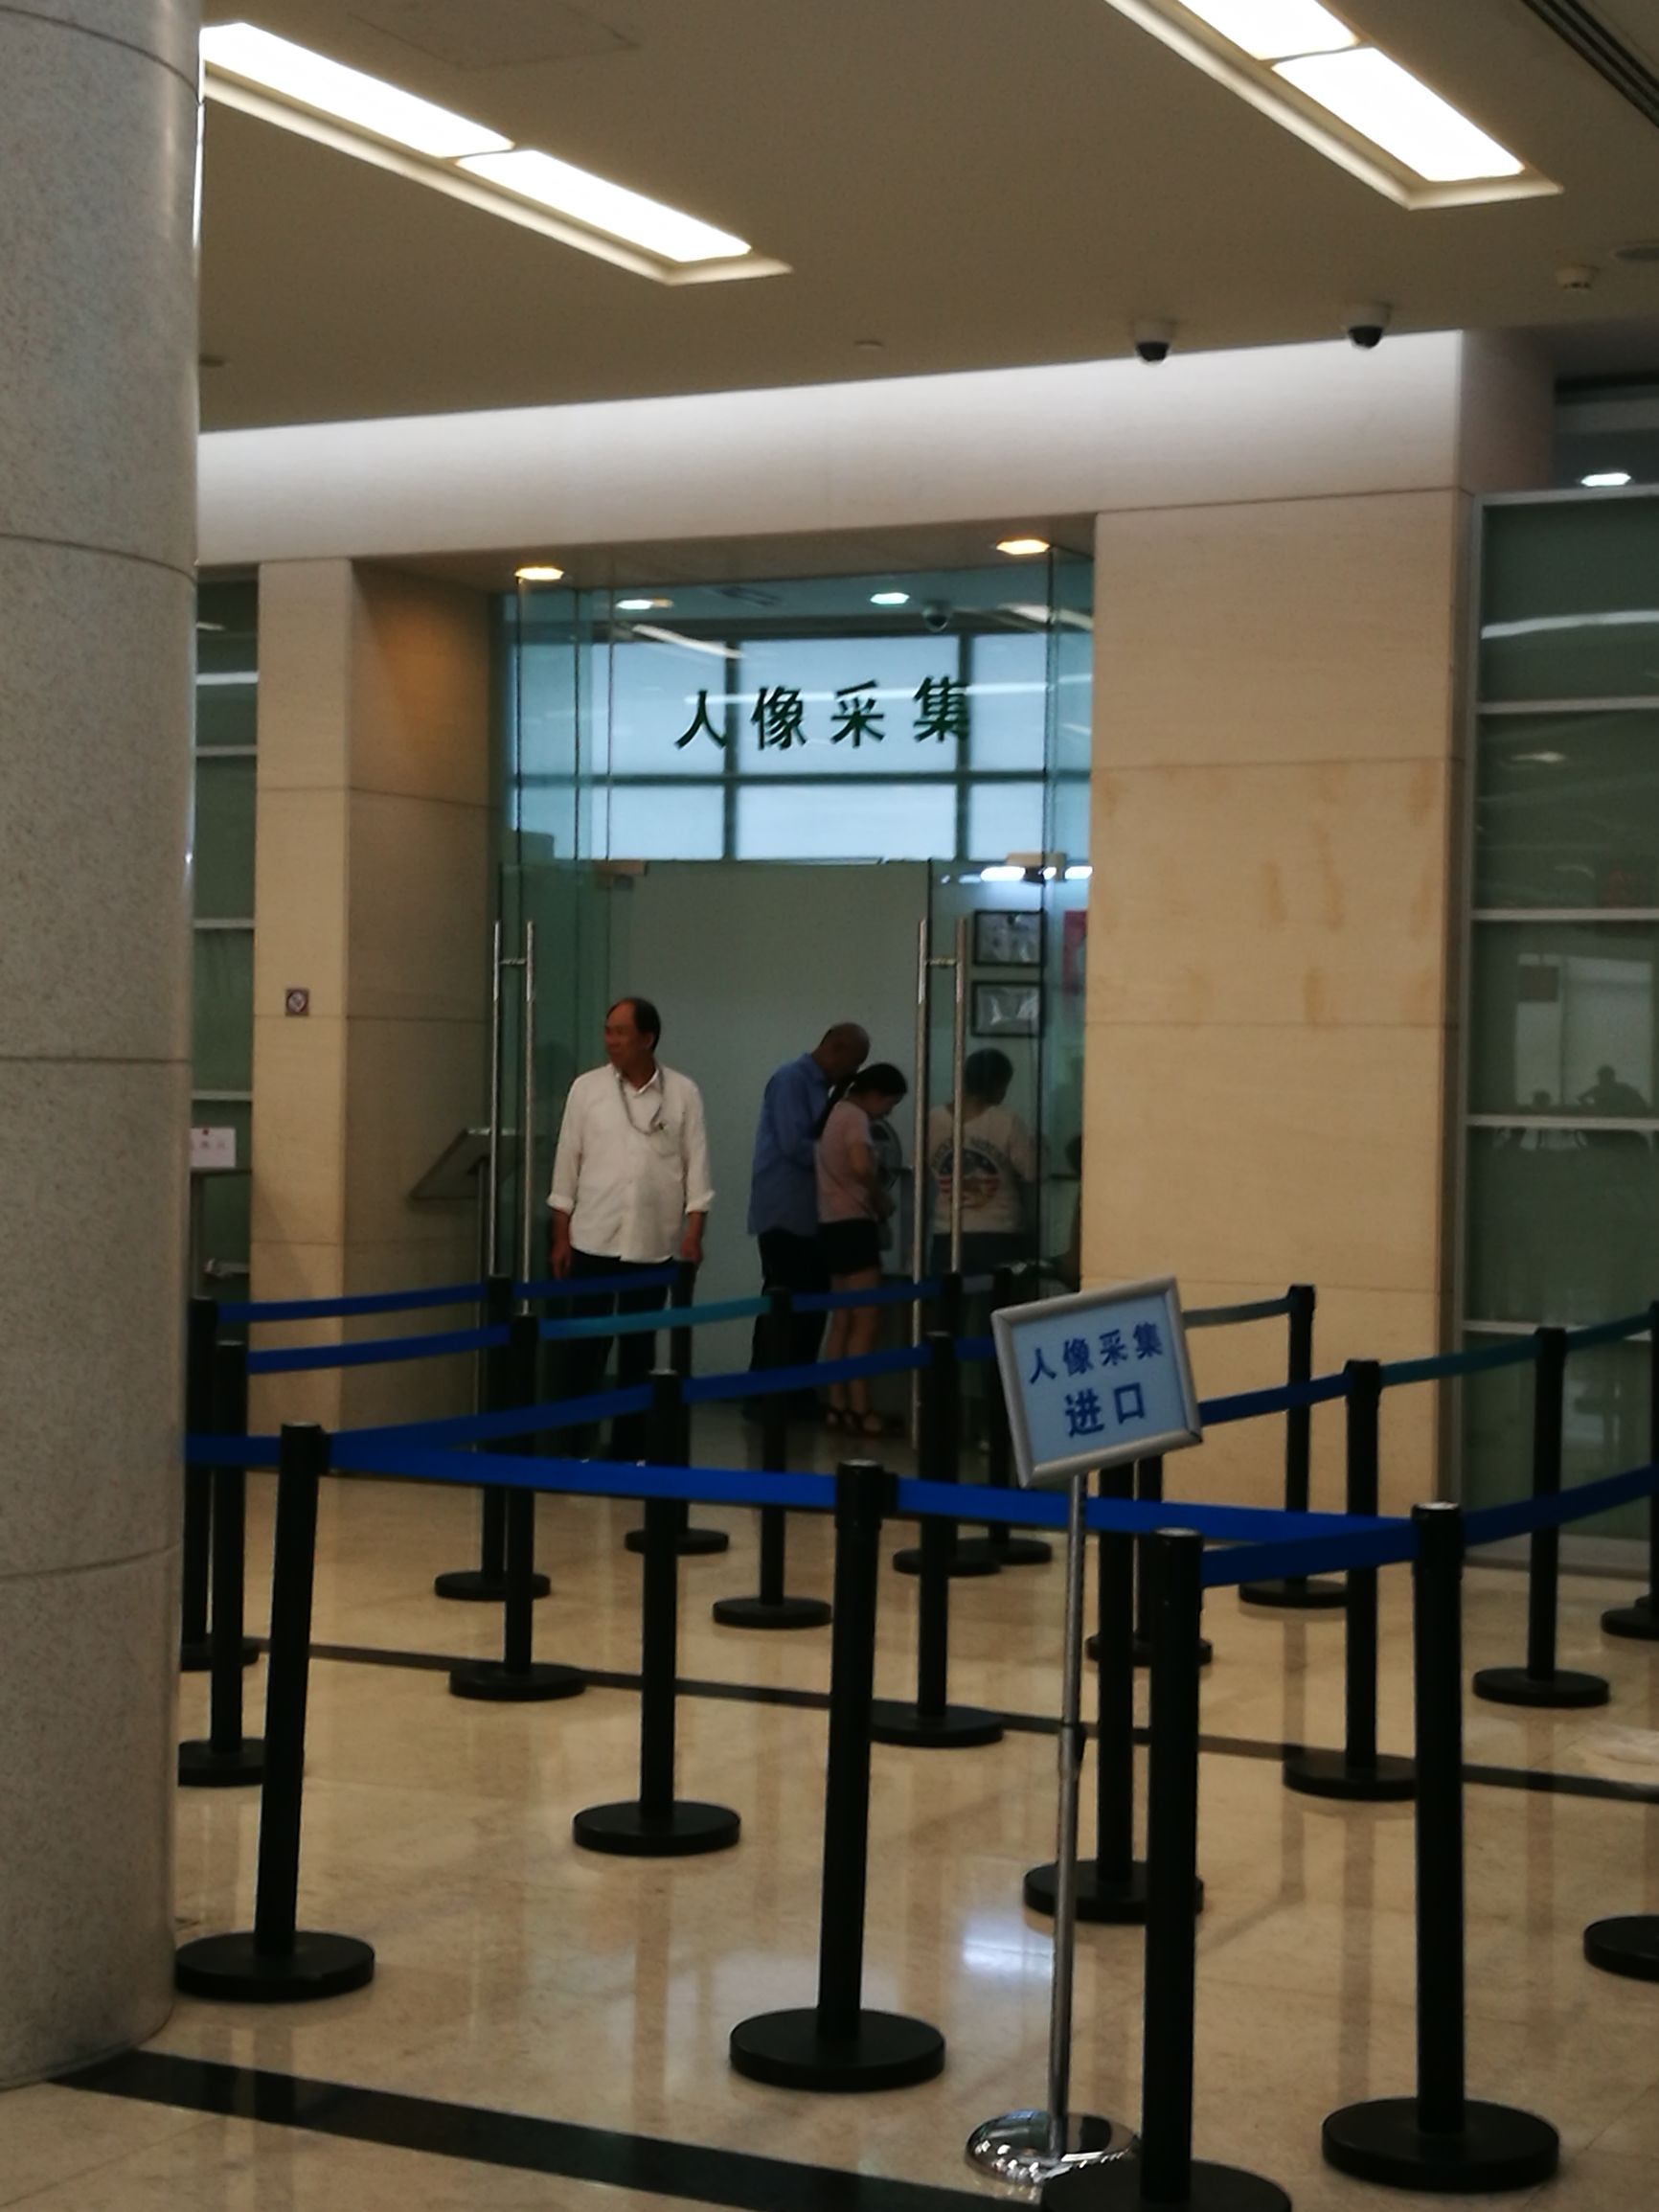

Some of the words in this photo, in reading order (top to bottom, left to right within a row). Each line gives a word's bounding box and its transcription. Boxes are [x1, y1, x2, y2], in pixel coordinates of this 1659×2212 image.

[674, 675, 969, 750] 人像采集
[1029, 1321, 1163, 1384] 人像采集
[1064, 1381, 1145, 1437] 进口
